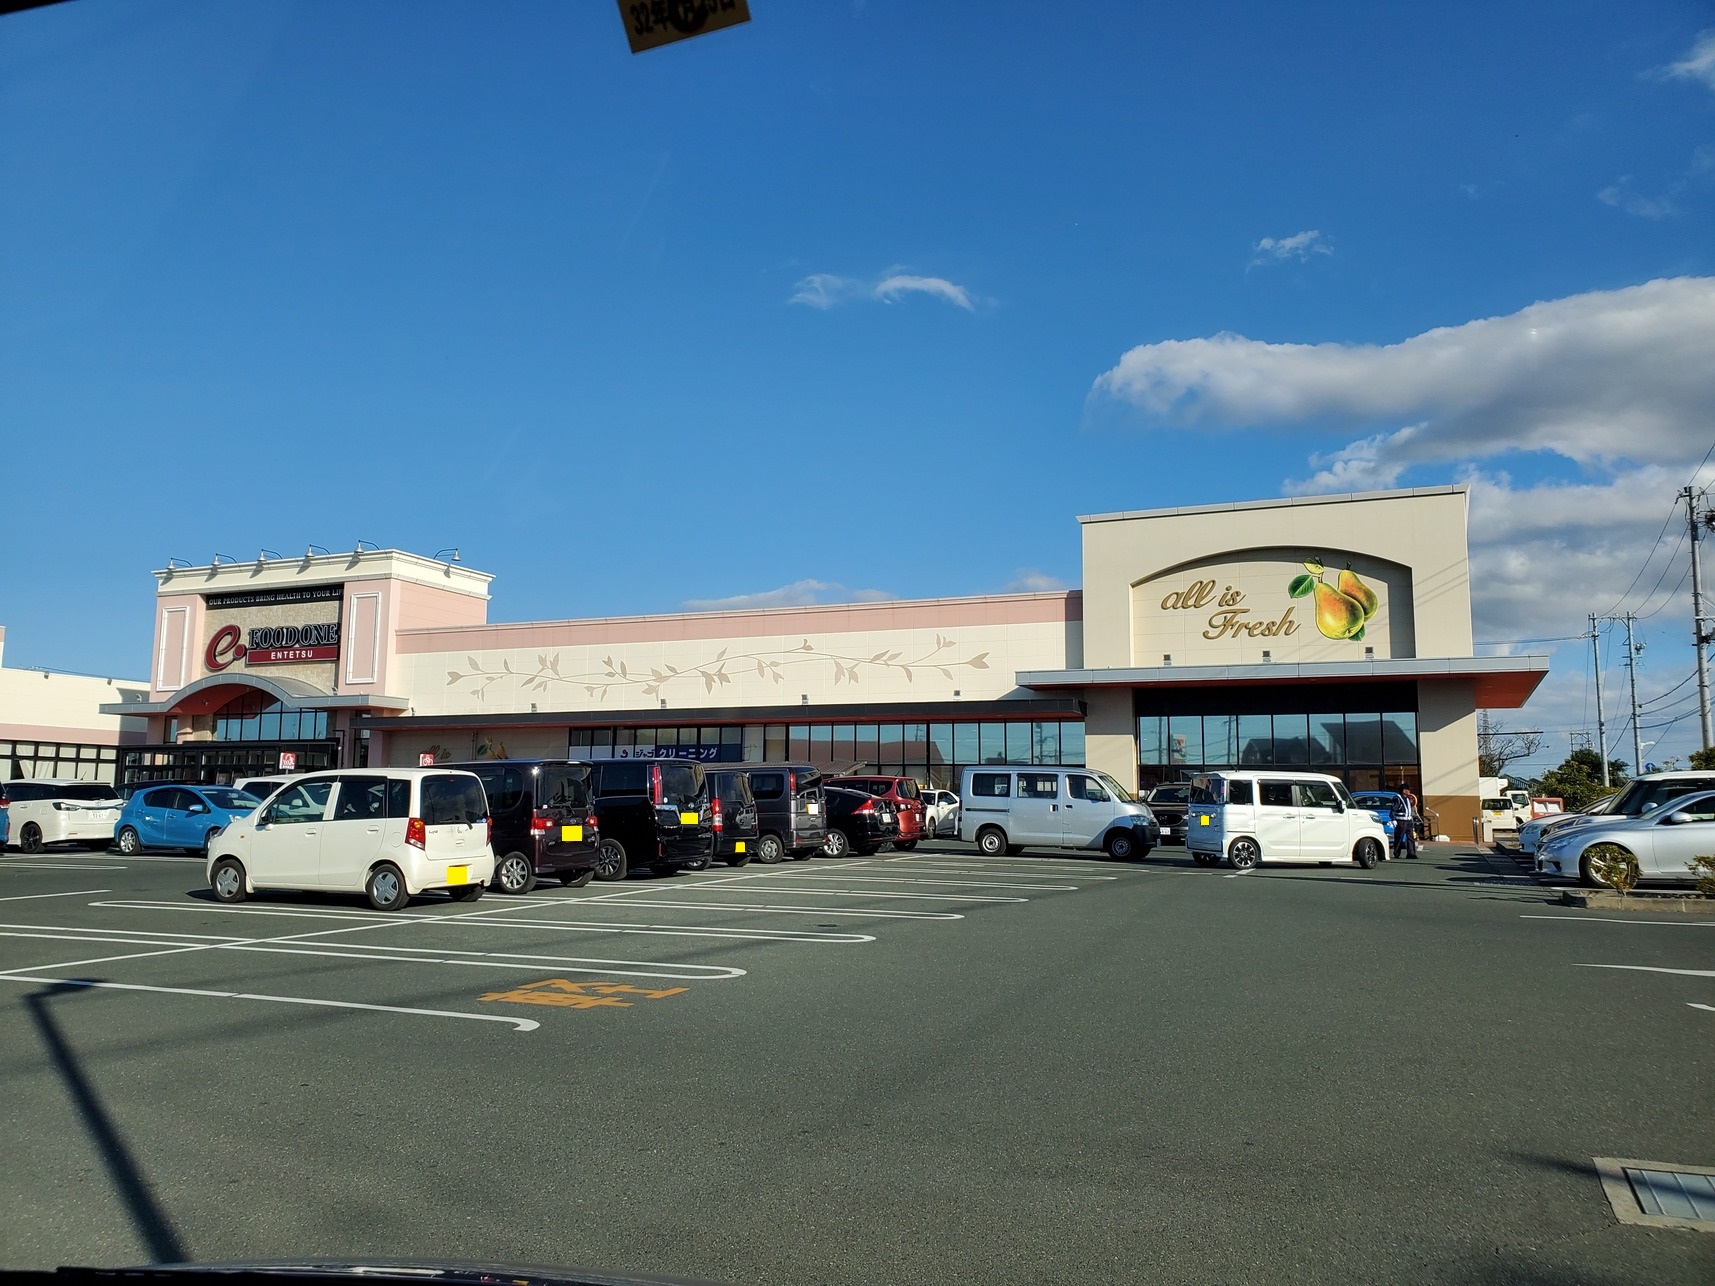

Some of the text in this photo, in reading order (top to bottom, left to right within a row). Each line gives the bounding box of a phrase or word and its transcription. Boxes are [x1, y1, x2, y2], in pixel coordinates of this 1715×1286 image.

[208, 598, 222, 606] OUR
[222, 596, 254, 605] PRODUCTS
[255, 594, 276, 602] BRING
[276, 593, 301, 601] HEALTH
[301, 591, 311, 599] TO
[312, 590, 331, 598] YOUR
[1161, 579, 1247, 610] all is
[1202, 606, 1302, 640] Fresh
[270, 649, 314, 660] ENTETSU
